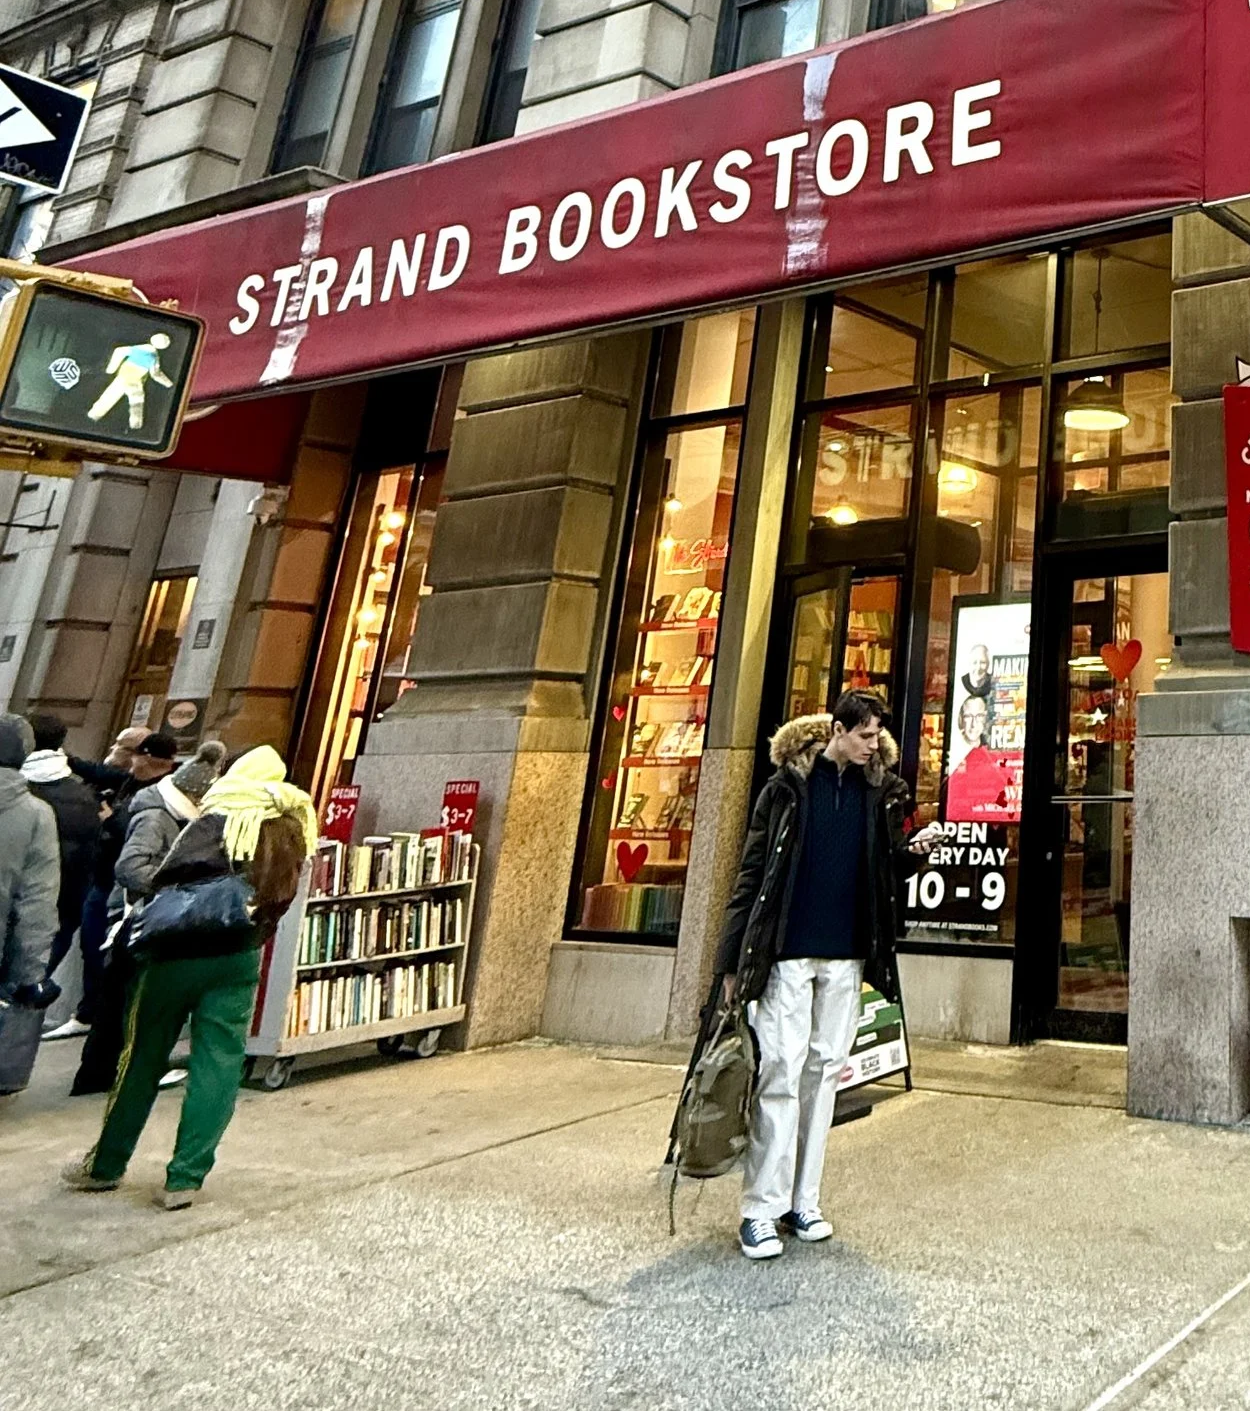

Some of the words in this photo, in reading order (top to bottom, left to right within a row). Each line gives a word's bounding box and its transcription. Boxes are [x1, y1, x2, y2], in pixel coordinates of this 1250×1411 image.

[229, 223, 471, 336] STRAND
[497, 79, 1002, 276] BOOKSTORE
[331, 787, 358, 799] SPECIAL
[445, 783, 477, 795] SPECIAL
[325, 801, 355, 826] $3-7
[441, 805, 474, 827] $3-7
[928, 846, 966, 866] ERY
[968, 846, 1010, 866] DAY
[904, 870, 945, 910] 10
[981, 871, 1006, 911] 9
